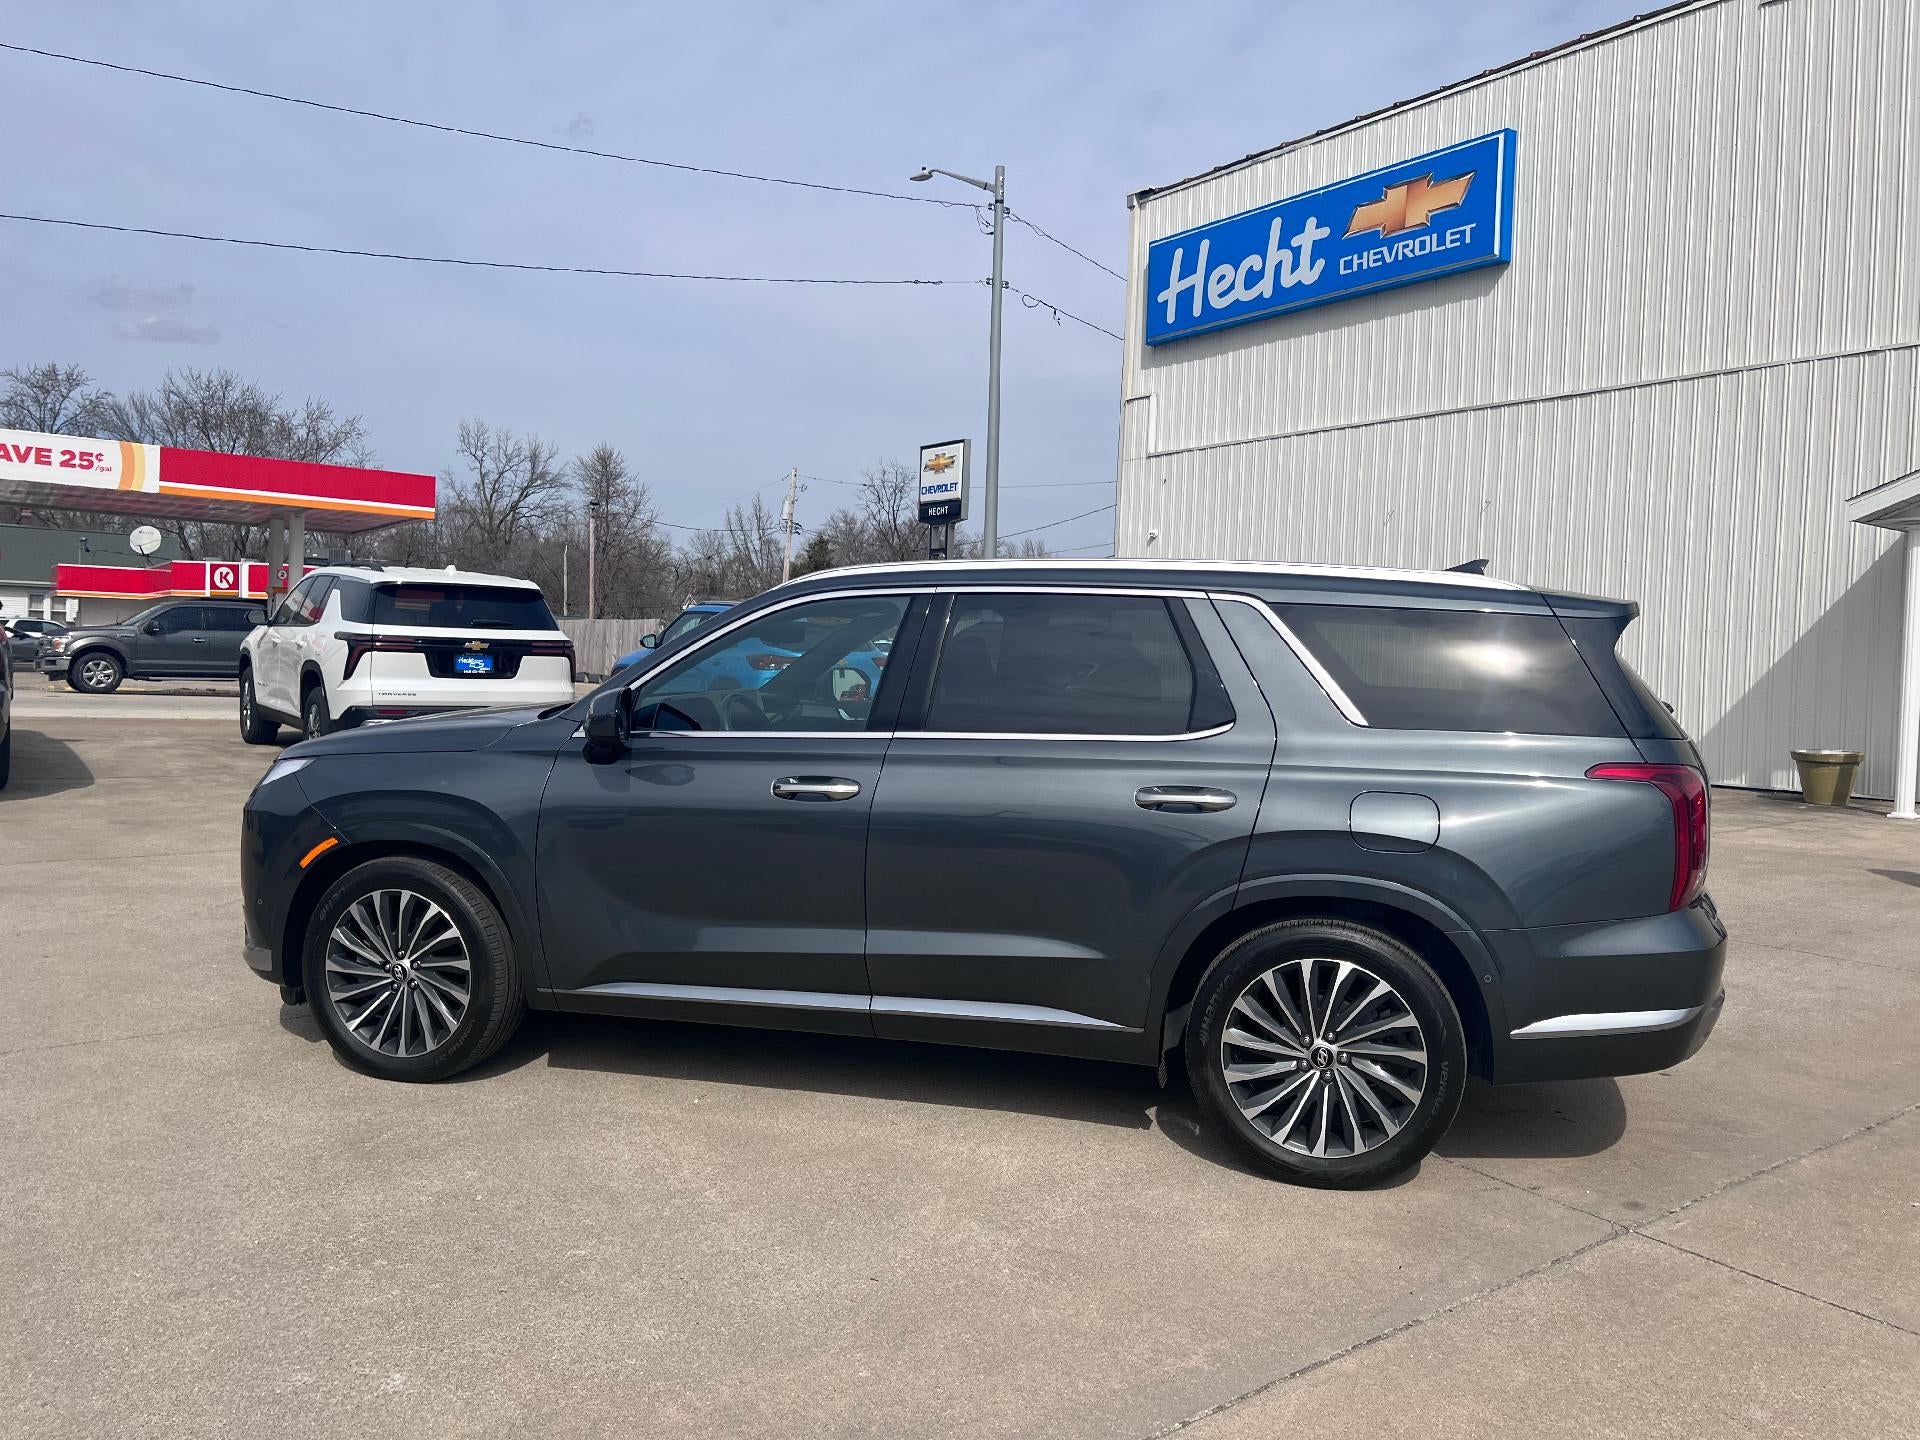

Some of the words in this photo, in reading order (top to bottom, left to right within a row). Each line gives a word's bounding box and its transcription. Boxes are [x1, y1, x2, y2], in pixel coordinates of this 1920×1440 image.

[1339, 222, 1477, 276] CHEVROLET
[1157, 216, 1331, 325] Hecht
[921, 482, 959, 496] CHEVROLET
[928, 505, 949, 517] HECHT
